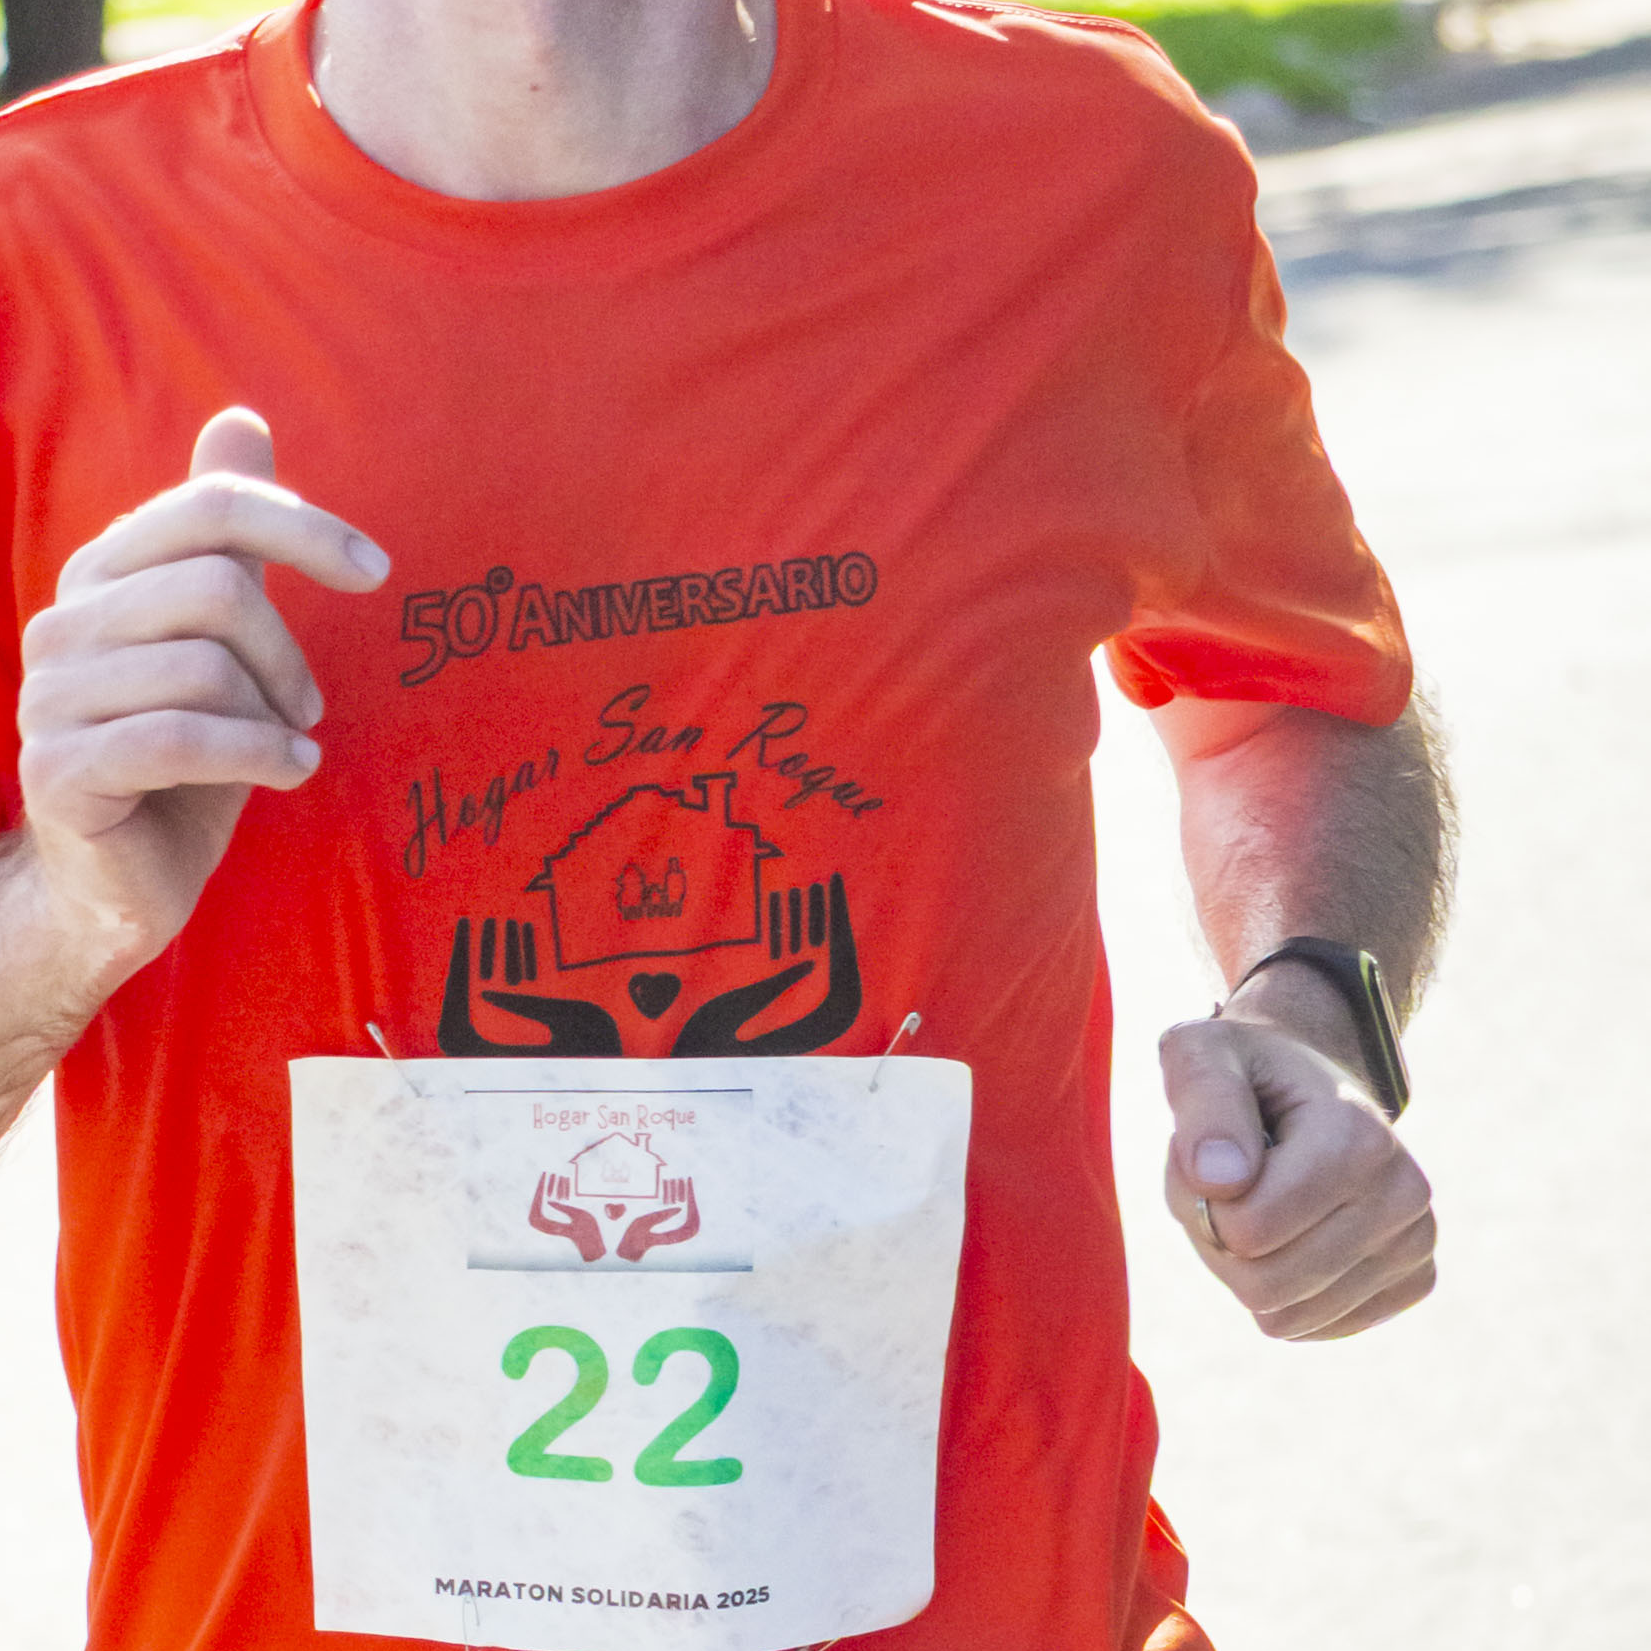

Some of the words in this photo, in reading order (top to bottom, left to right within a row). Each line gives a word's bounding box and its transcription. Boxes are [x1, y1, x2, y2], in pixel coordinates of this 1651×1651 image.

[508, 551, 879, 652] ANIVERSARIO
[403, 747, 560, 880] Hogar
[583, 683, 705, 767] San
[725, 701, 884, 820] Roque
[533, 1102, 591, 1132] Hogar
[597, 1103, 631, 1130] San
[636, 1103, 697, 1131] Roque
[501, 1325, 744, 1488] 22
[435, 1577, 564, 1603] MARATON
[571, 1586, 710, 1611] SOLIDARIA
[717, 1585, 771, 1610] 2025
